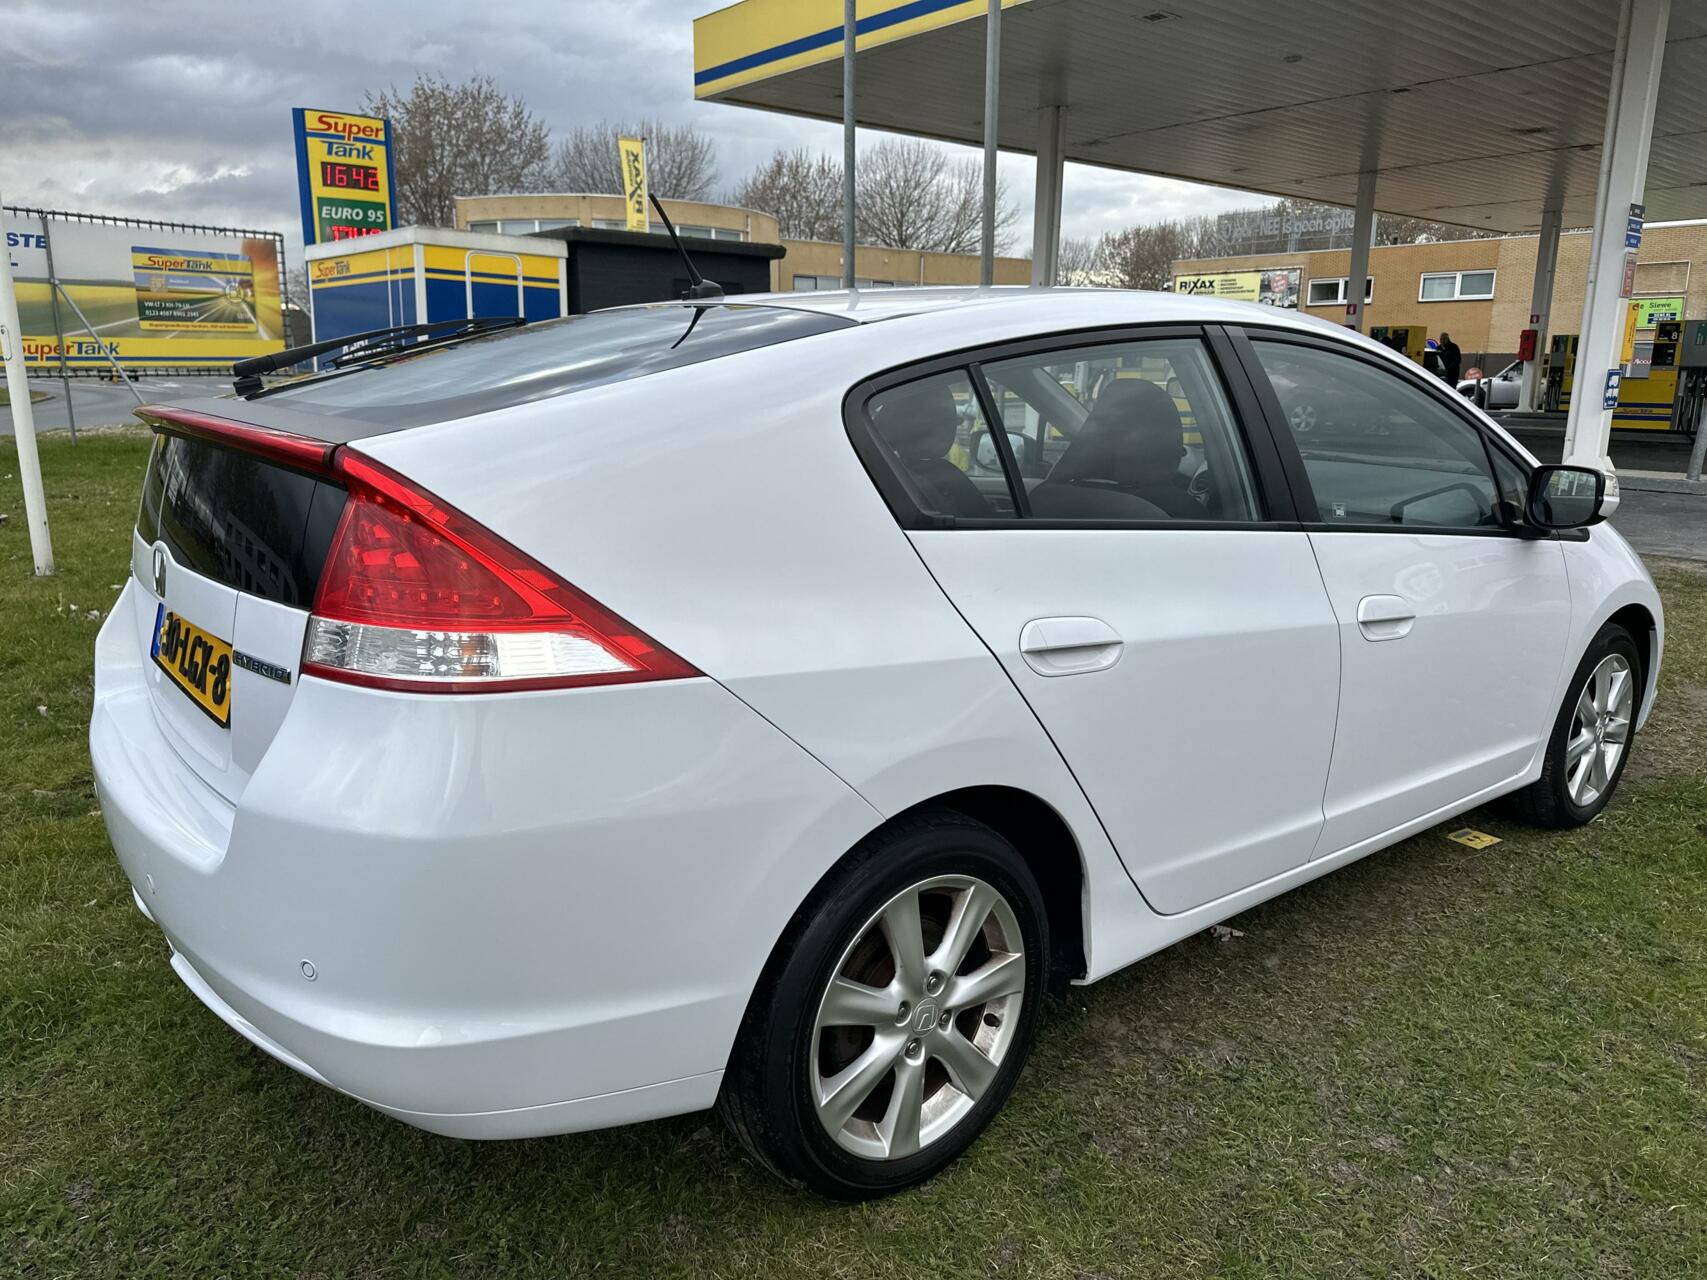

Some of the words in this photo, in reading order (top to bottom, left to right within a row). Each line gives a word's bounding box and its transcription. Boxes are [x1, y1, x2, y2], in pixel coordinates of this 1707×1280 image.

[306, 114, 384, 142] Super
[320, 140, 374, 160] Tank
[321, 206, 363, 221] EURO
[367, 209, 384, 222] 95
[1179, 278, 1216, 295] RIXAX
[234, 652, 288, 680] HYBRID
